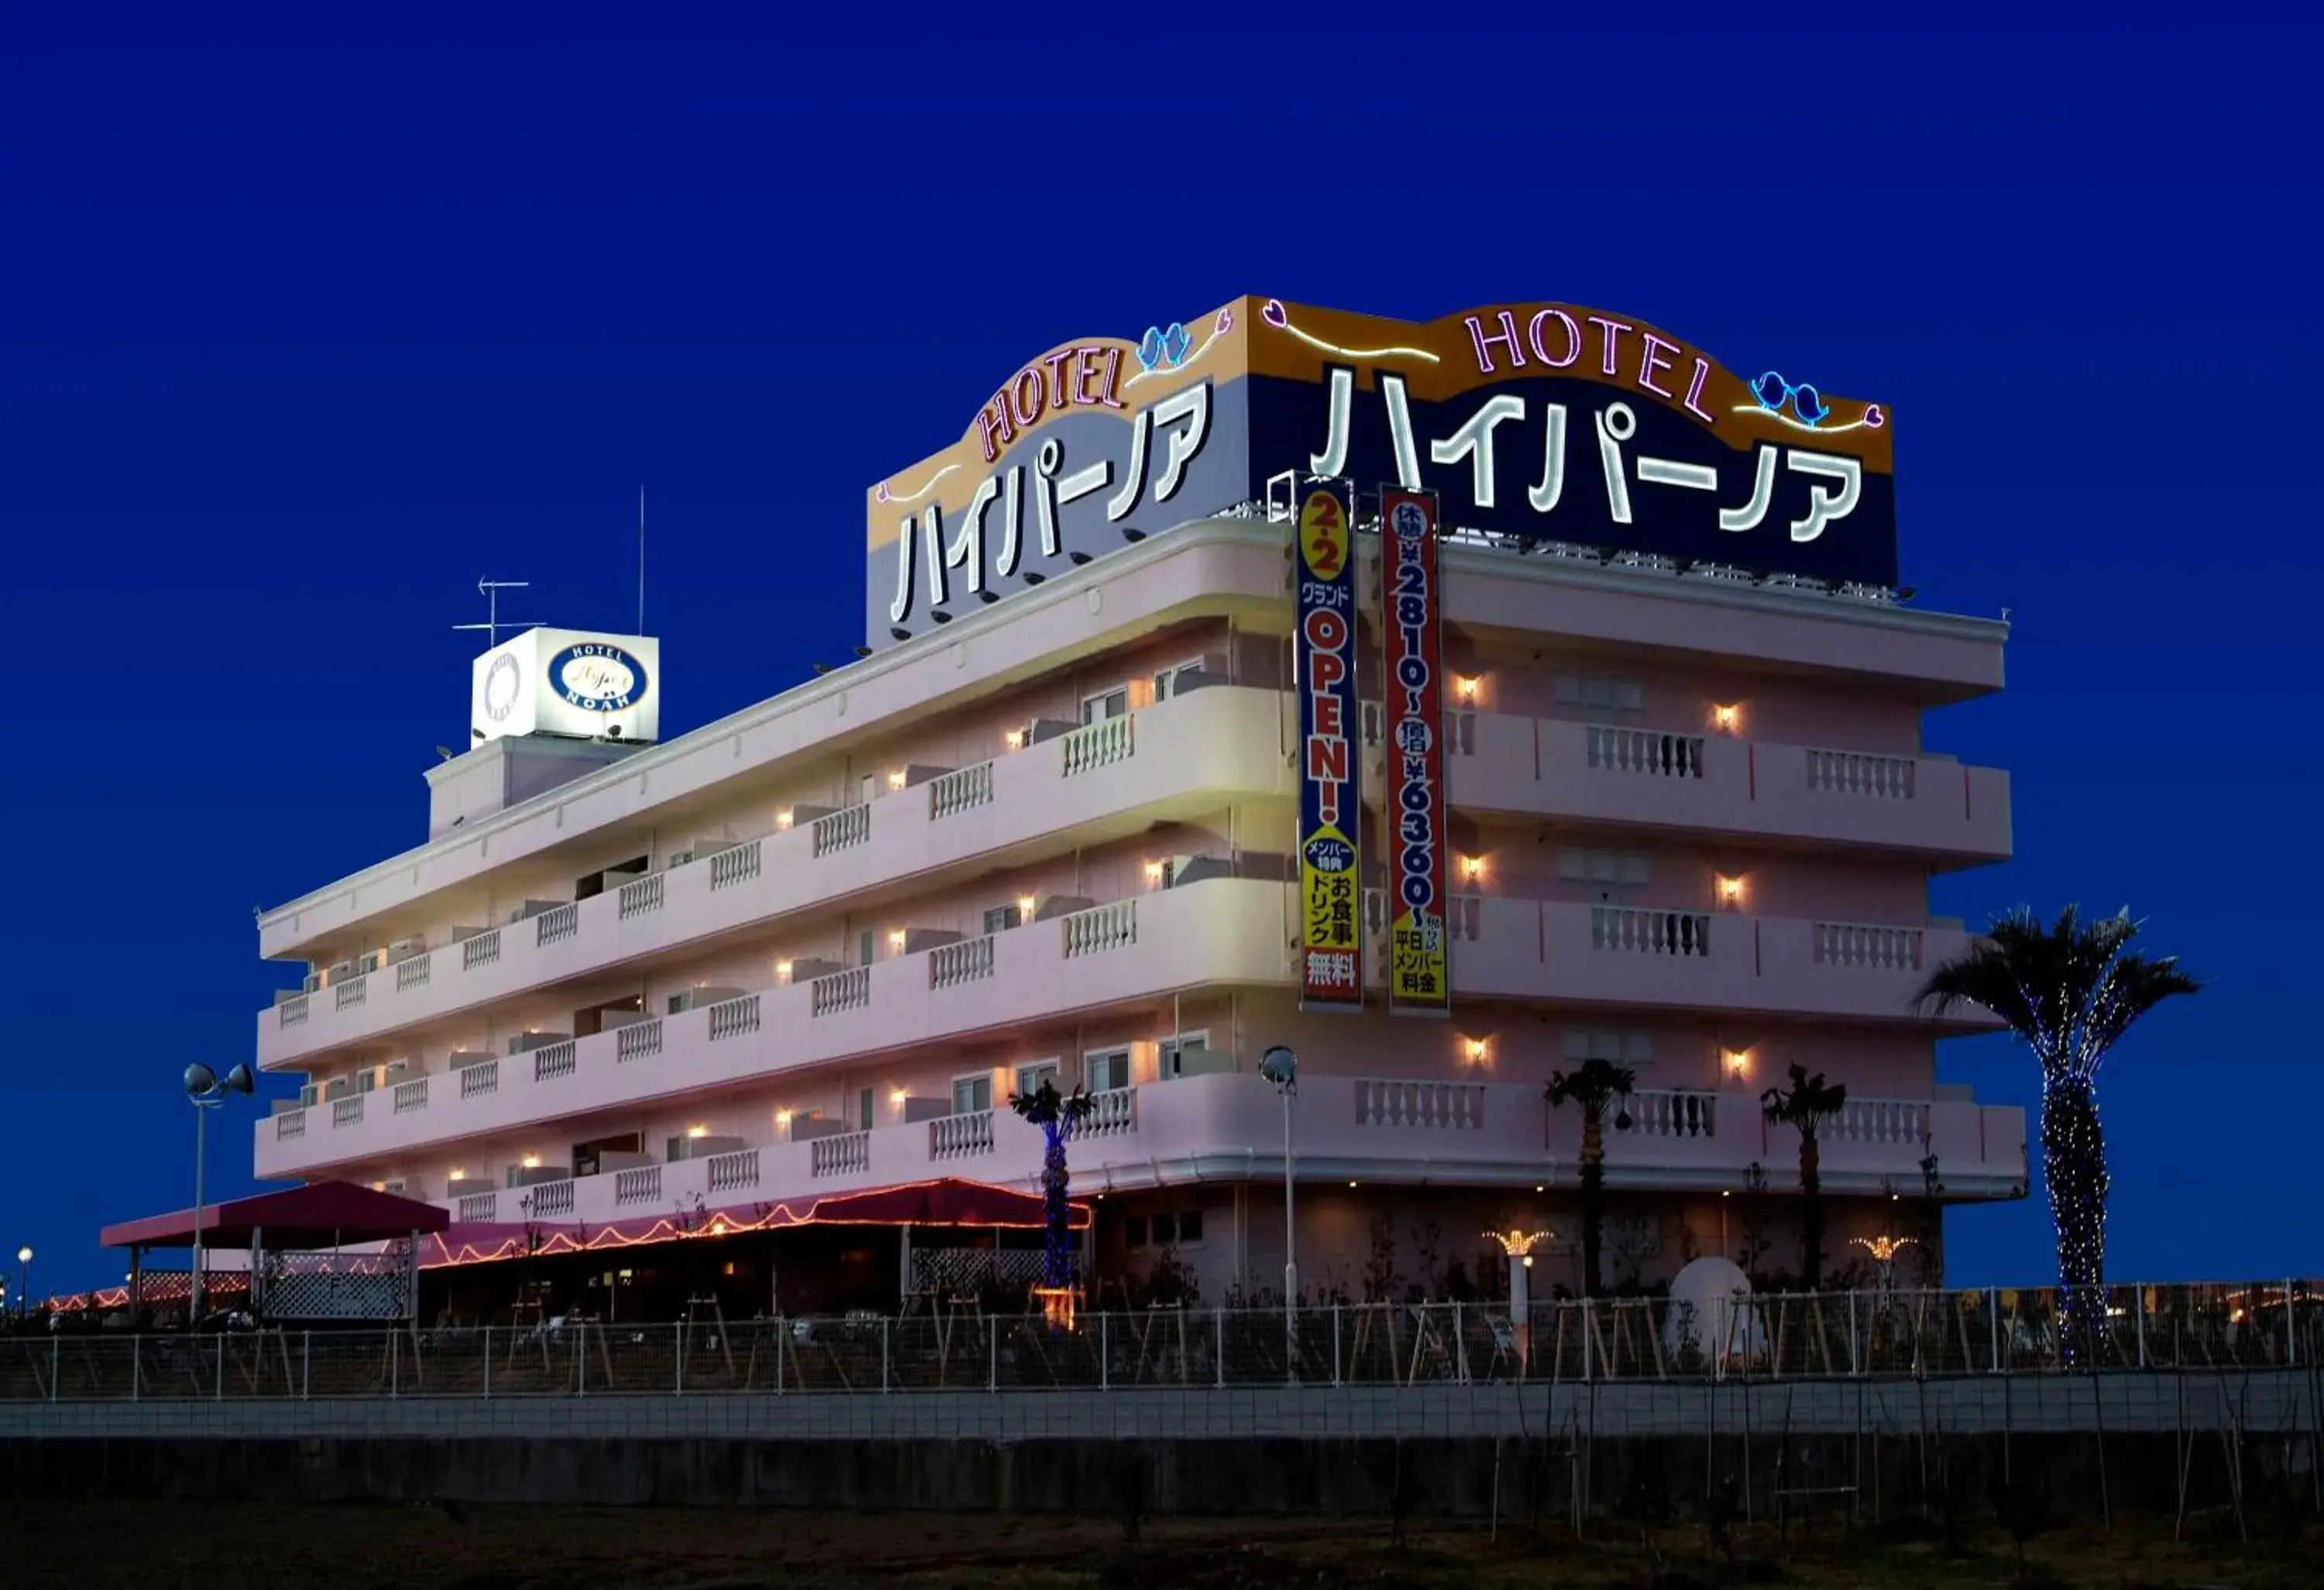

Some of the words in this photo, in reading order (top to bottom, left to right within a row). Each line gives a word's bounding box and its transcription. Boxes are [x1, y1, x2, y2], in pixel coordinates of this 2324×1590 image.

[1464, 309, 1714, 423] HOTEL
[977, 346, 1129, 463] HOTEL
[1310, 368, 1862, 542] ハイパーノア
[890, 379, 1212, 622] ハイパーノア
[1303, 582, 1349, 607] グランド
[572, 645, 622, 661] HOTEL
[566, 690, 629, 710] NOAH
[1308, 841, 1350, 855] メンバー
[1311, 874, 1329, 944] ドリンク
[1332, 876, 1353, 945] お食事
[1395, 931, 1422, 951] 平日
[1308, 952, 1355, 987] 無料
[1396, 953, 1442, 969] メンバー
[1401, 973, 1436, 993] 料金
